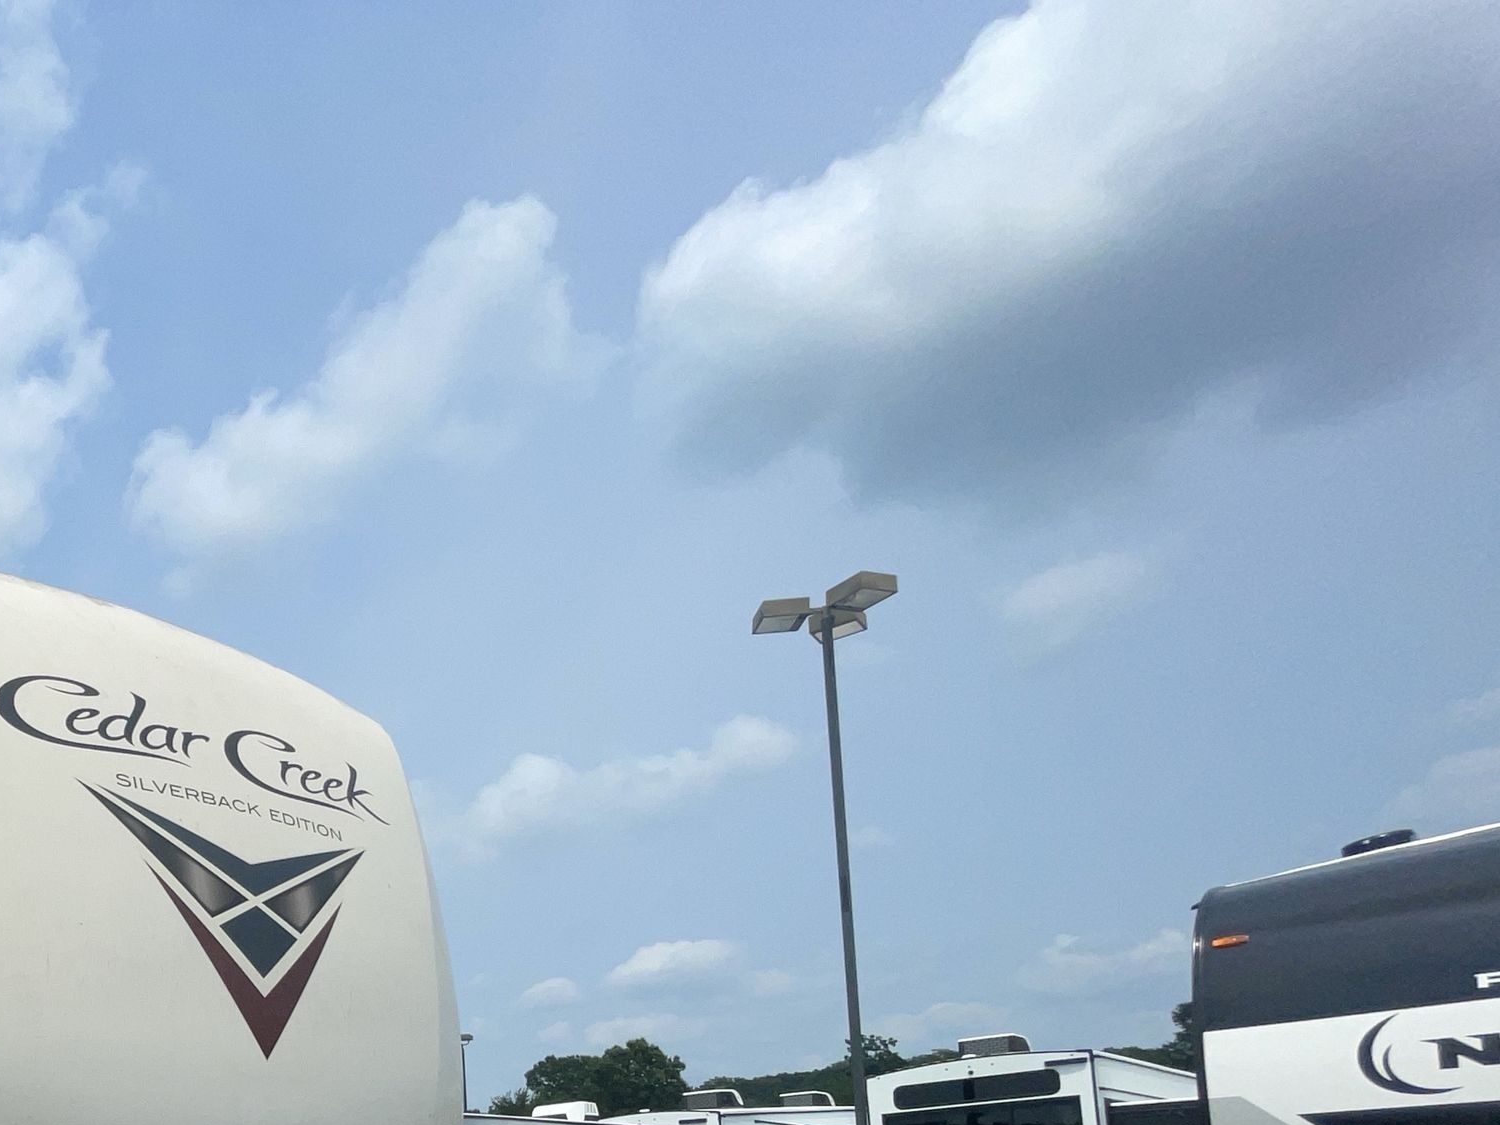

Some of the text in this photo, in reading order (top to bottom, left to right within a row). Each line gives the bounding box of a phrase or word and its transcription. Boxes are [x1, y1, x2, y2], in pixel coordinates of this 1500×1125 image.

[115, 772, 343, 843] SILVERBACK EDITION
[224, 729, 391, 826] Creek
